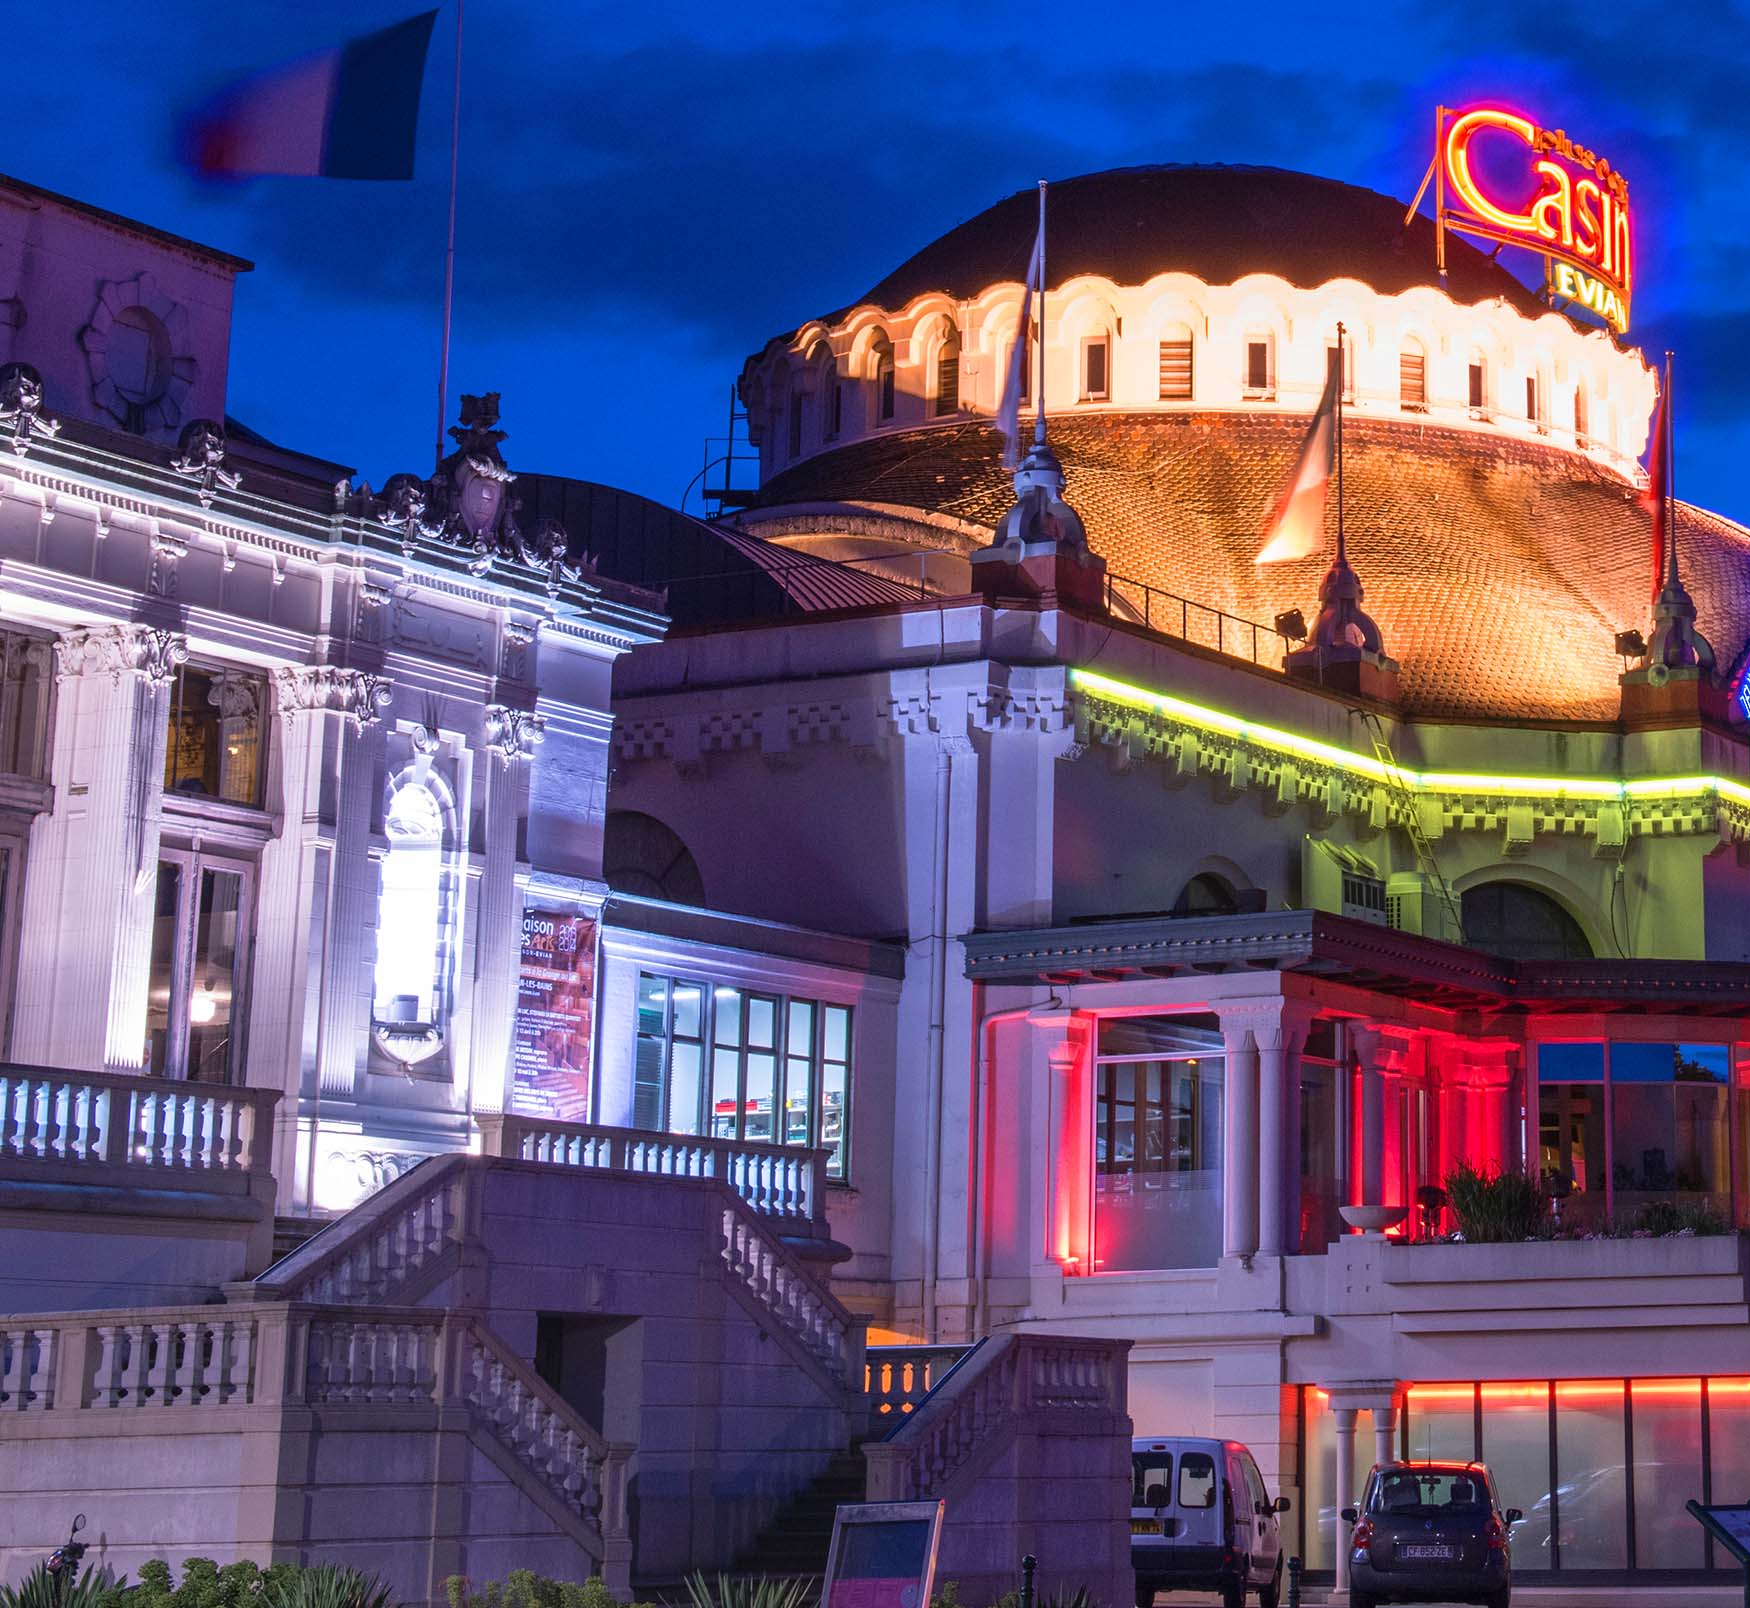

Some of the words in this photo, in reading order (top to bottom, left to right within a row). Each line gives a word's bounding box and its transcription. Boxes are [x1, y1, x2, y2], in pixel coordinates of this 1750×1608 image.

[1447, 110, 1630, 292] Casin
[1555, 263, 1628, 333] EVIAN
[520, 932, 531, 946] es
[523, 915, 554, 936] aison
